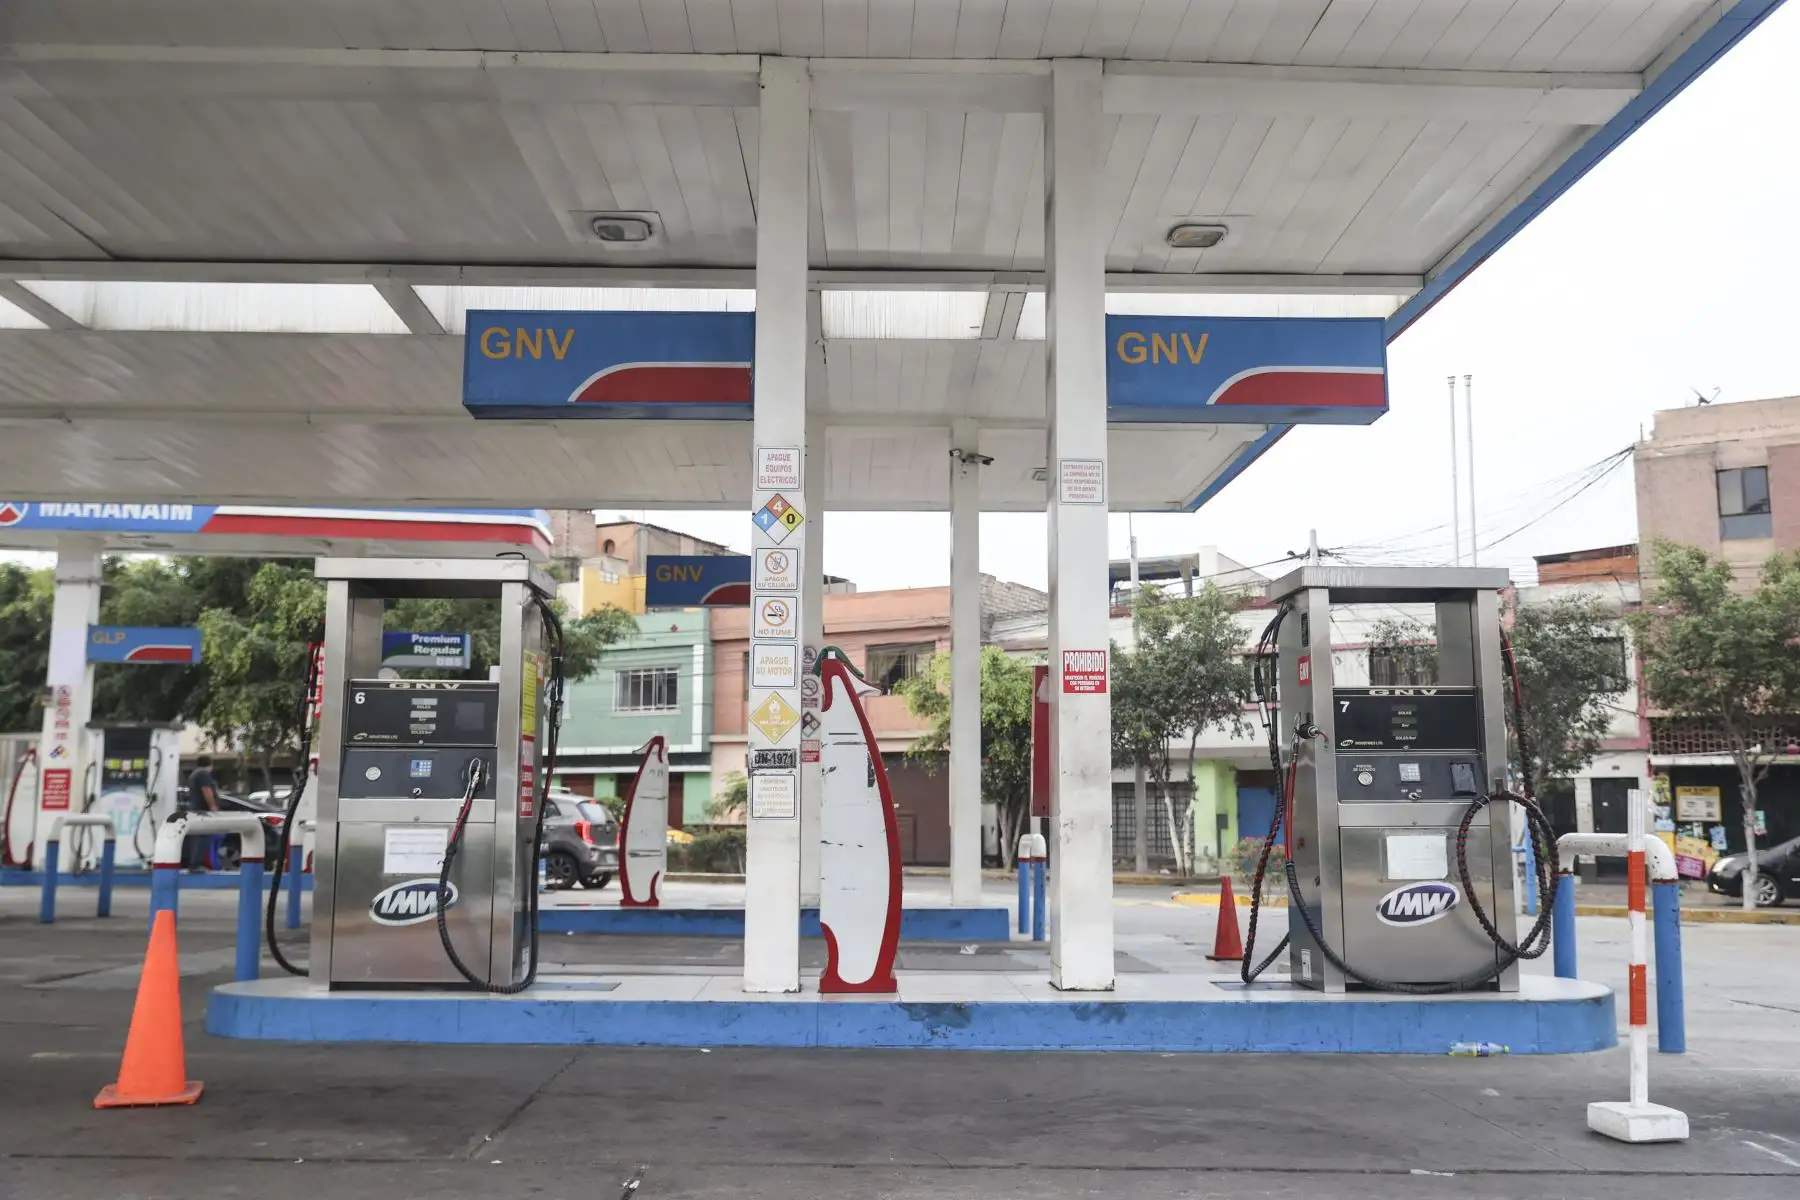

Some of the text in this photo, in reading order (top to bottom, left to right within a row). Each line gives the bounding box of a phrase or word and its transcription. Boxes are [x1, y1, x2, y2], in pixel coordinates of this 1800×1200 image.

[480, 326, 575, 361] GNV
[1116, 332, 1209, 365] GNV
[767, 453, 791, 461] APAGUE
[765, 464, 792, 473] EQUIPOS
[39, 503, 193, 521] MAHANAIM
[773, 500, 783, 512] 4
[760, 513, 768, 525] 1
[786, 513, 796, 525] 0
[655, 564, 703, 582] GNV
[92, 631, 126, 644] GLP
[758, 628, 793, 636] NO FUME
[411, 634, 461, 644] Premium
[414, 645, 462, 656] Regular
[760, 656, 789, 665] APAGUE
[1064, 651, 1105, 673] PROHIBIDO
[755, 666, 766, 676] SU
[768, 667, 793, 676] MOTOR
[389, 682, 461, 690] GNV
[1368, 688, 1438, 696] GNV
[354, 692, 366, 705] 6
[1339, 701, 1350, 713] 7
[754, 752, 793, 765] UN-1971
[380, 890, 449, 915] IMW
[1387, 891, 1452, 916] IMW
